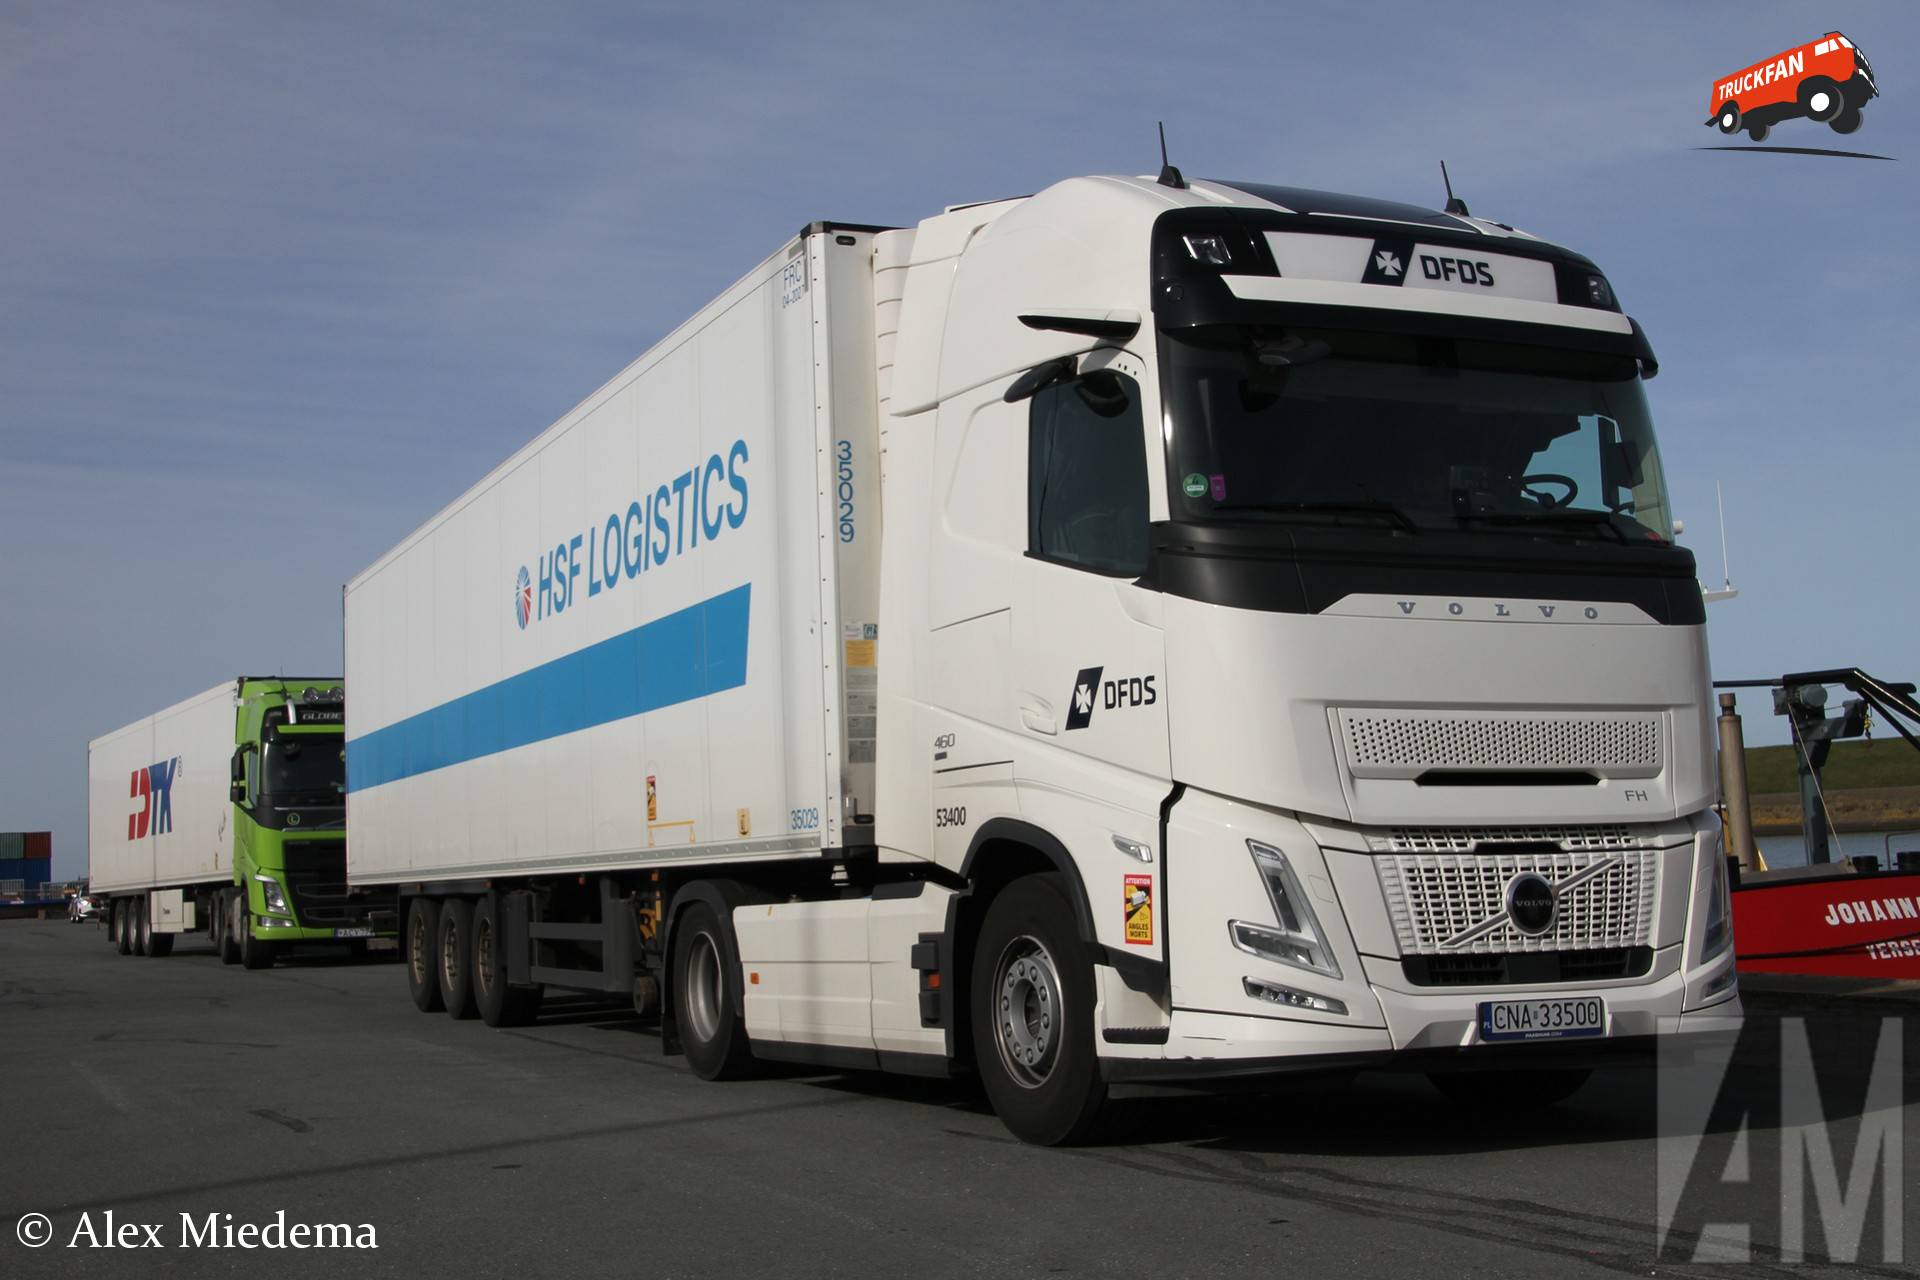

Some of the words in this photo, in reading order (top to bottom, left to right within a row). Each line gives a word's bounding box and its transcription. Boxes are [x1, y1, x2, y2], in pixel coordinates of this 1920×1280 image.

[1419, 254, 1494, 287] DFDS
[837, 440, 855, 543] 35029
[537, 533, 583, 621] HSF
[588, 439, 749, 598] LOGISTICS
[1397, 601, 1599, 620] VOLVO
[1104, 675, 1157, 709] DFDS
[934, 733, 955, 749] 460
[1624, 790, 1648, 802] FH
[790, 807, 819, 830] 35029
[936, 806, 967, 828] 53400
[1516, 899, 1552, 907] VOLVO
[1825, 896, 1920, 926] JOHANN
[1128, 923, 1149, 931] ANGLES
[1494, 1003, 1532, 1030] CNA
[1539, 1001, 1598, 1027] 33500
